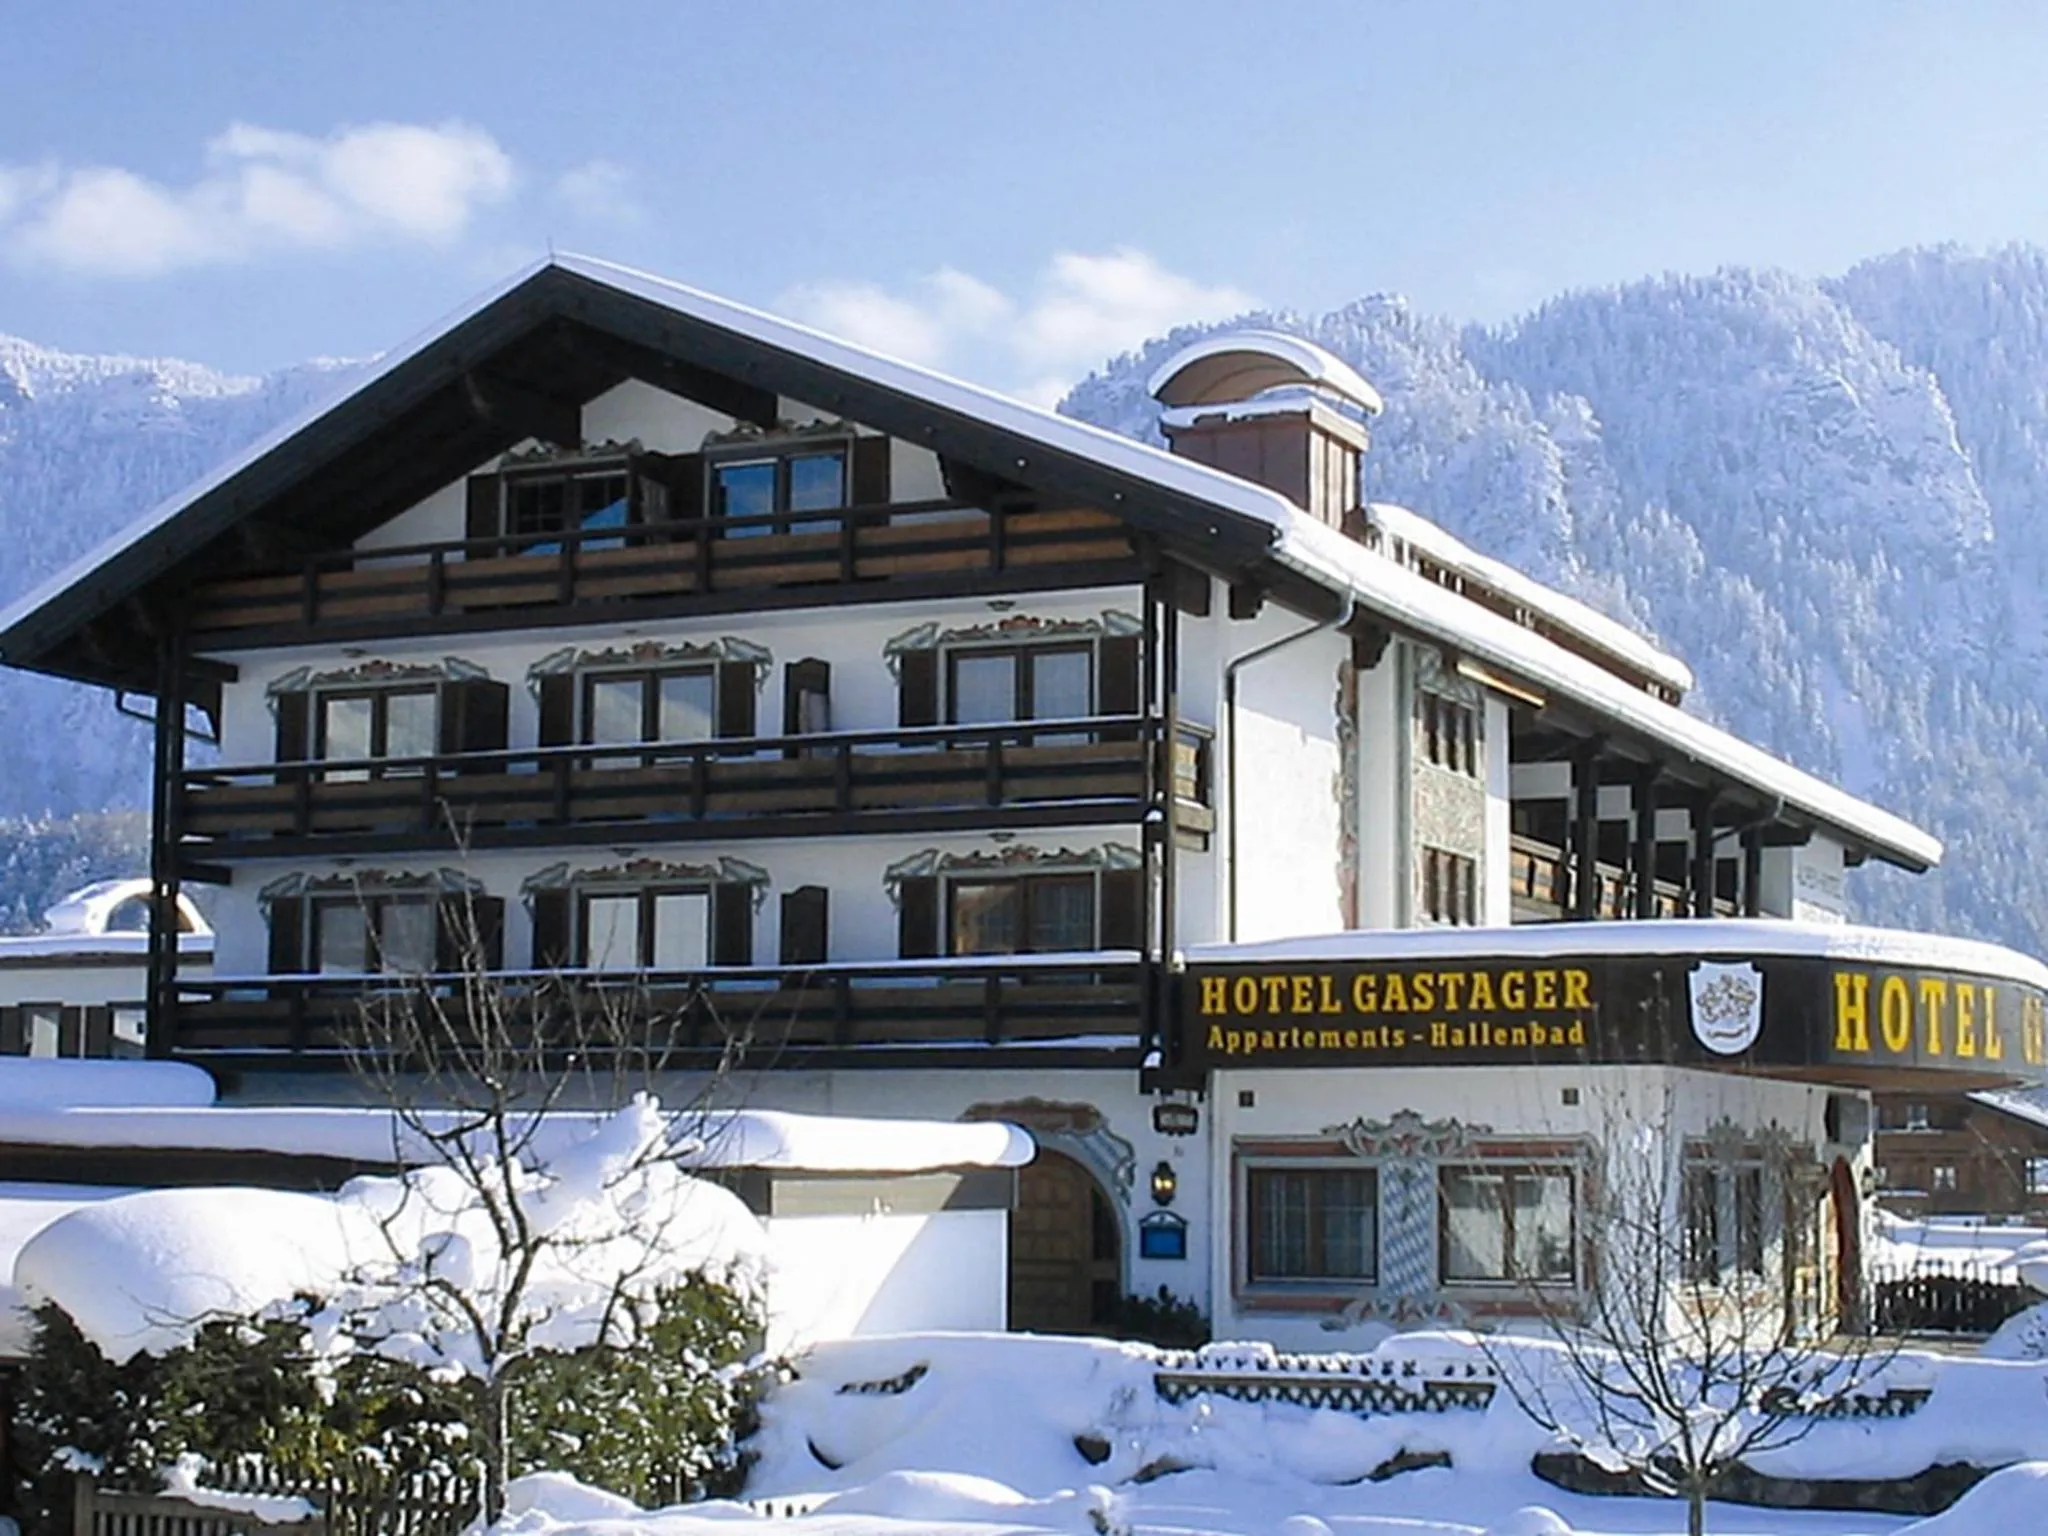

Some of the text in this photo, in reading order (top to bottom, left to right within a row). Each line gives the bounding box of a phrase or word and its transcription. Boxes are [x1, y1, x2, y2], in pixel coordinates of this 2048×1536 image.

[1201, 969, 1593, 1015] HOTEL GASTAGER
[1208, 1024, 1405, 1053] Appartements
[1430, 1020, 1585, 1047] Hallenbad
[1833, 971, 2005, 1061] HOTEL
